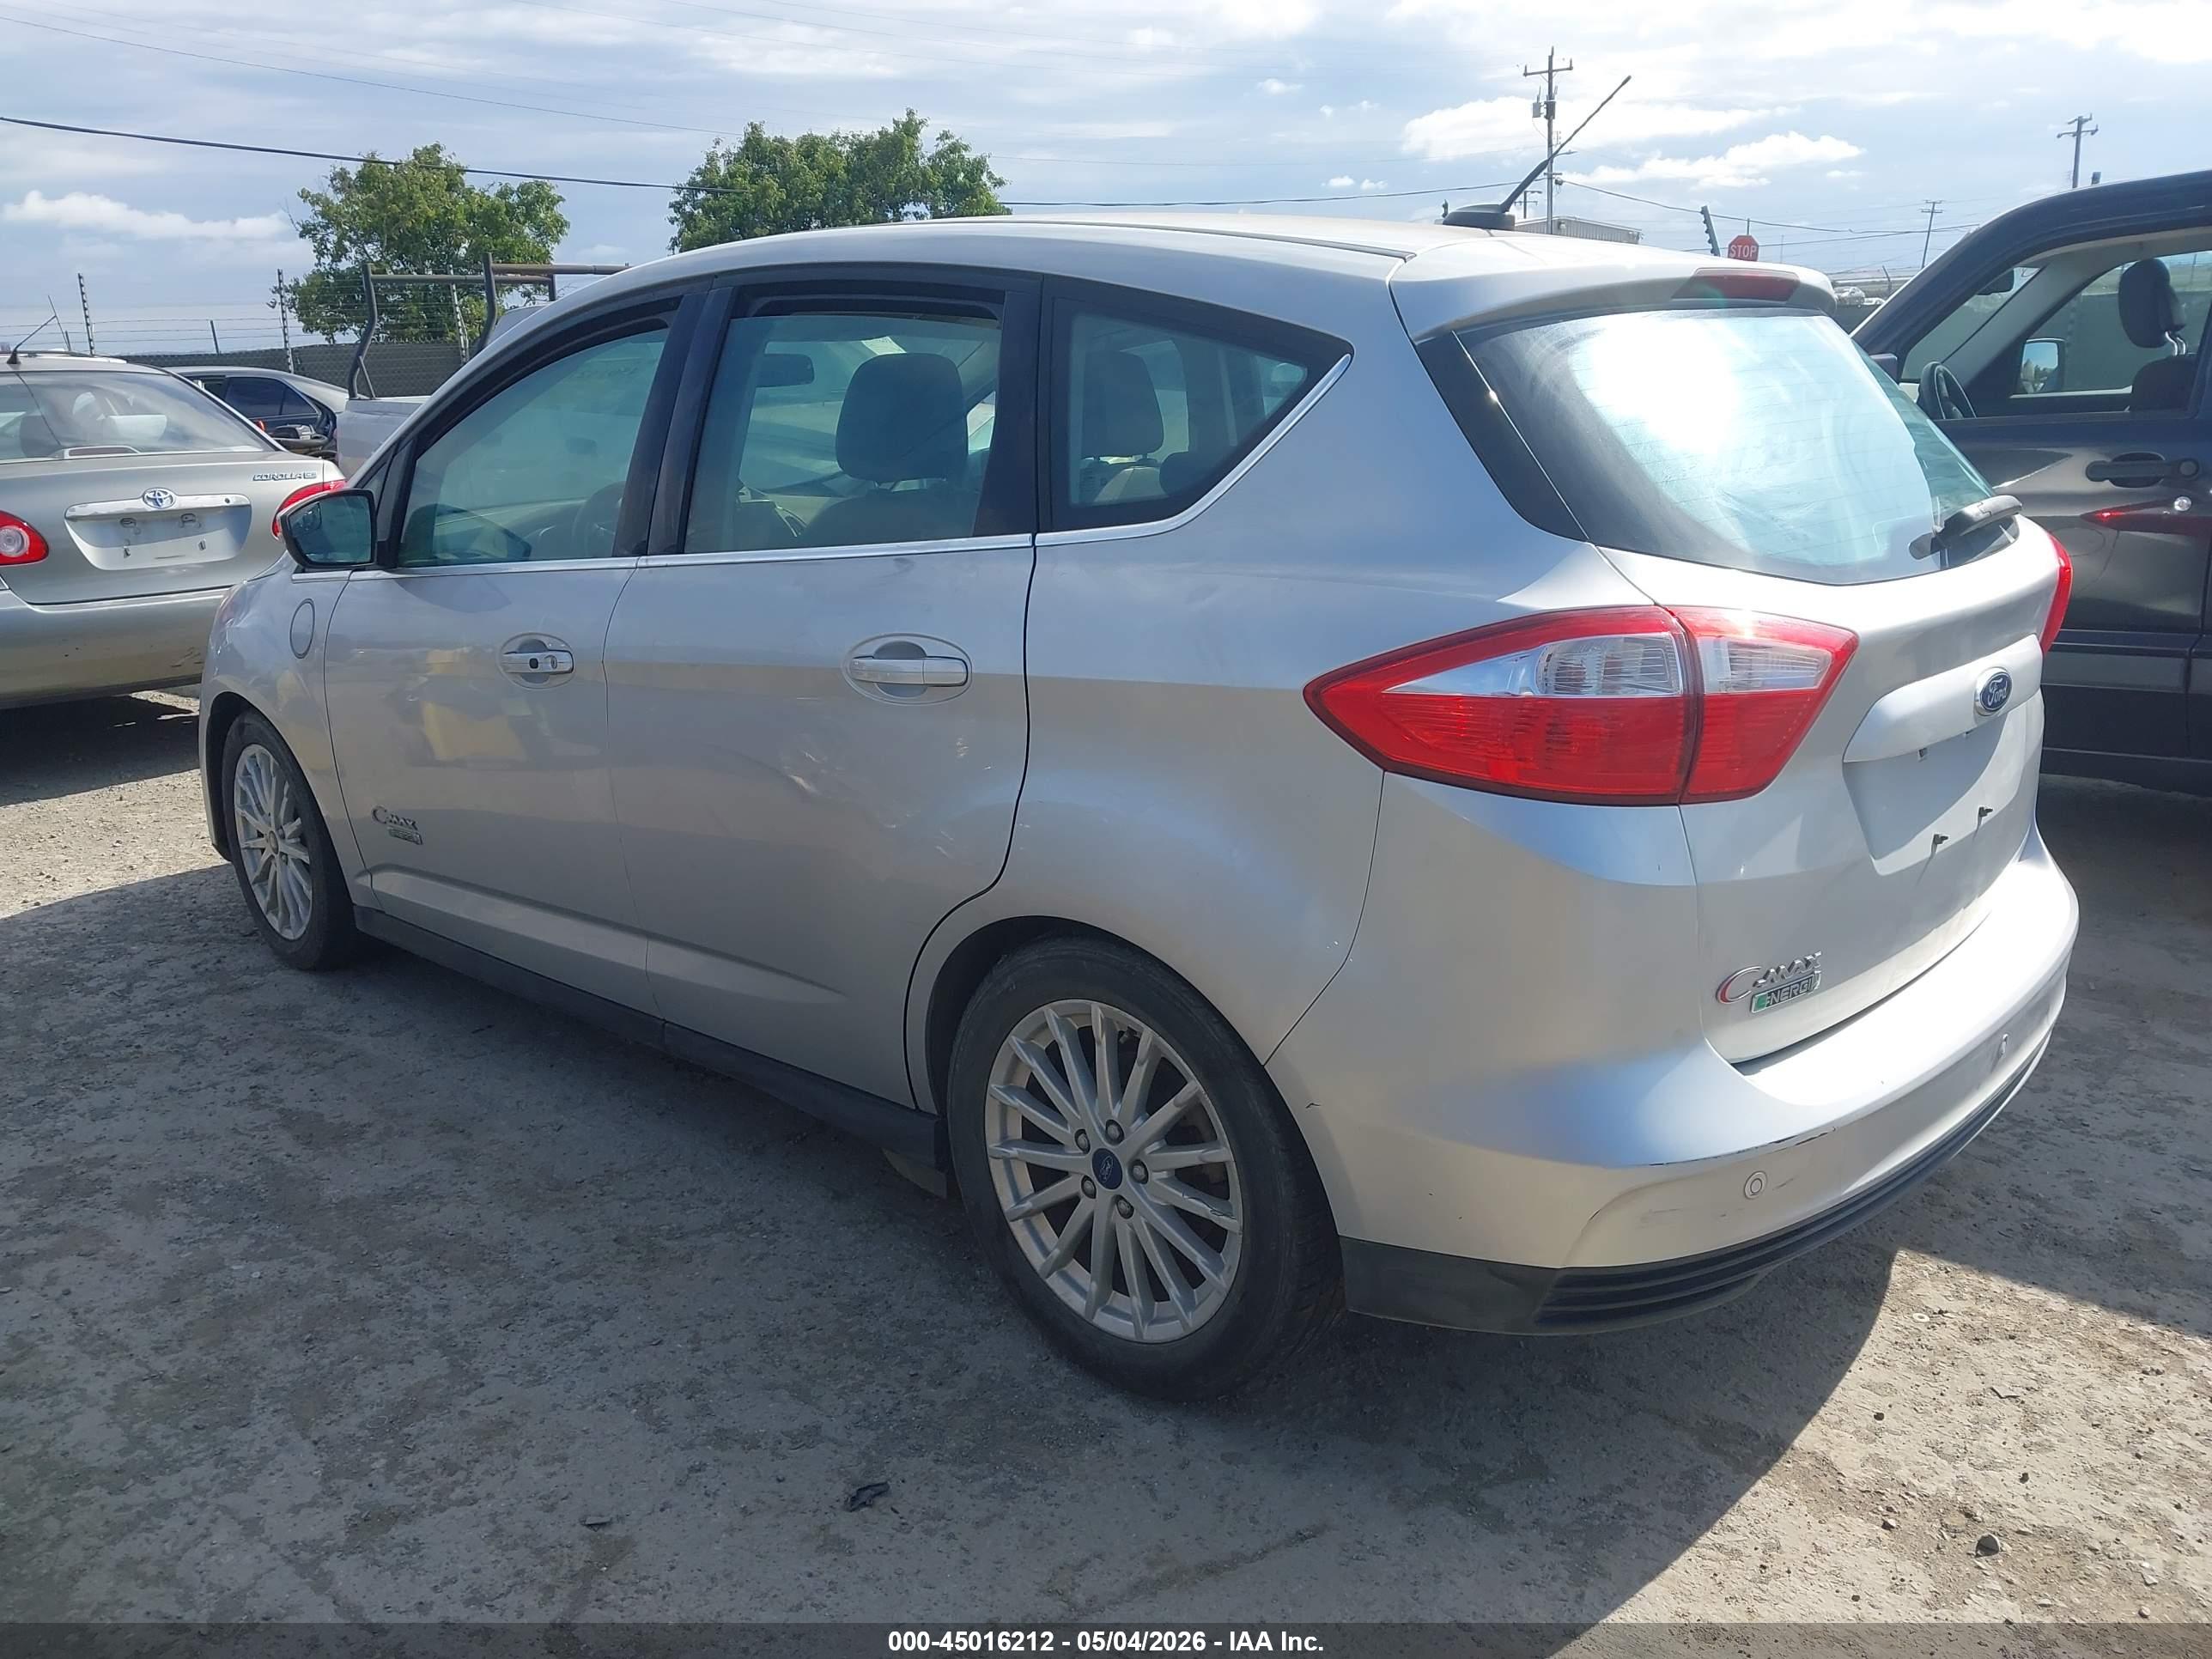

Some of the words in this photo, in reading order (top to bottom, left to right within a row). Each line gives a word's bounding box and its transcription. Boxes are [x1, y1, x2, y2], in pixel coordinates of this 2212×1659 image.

[1730, 245, 1757, 258] STOP
[252, 472, 302, 482] COROLLA
[1987, 677, 2008, 706] Ford
